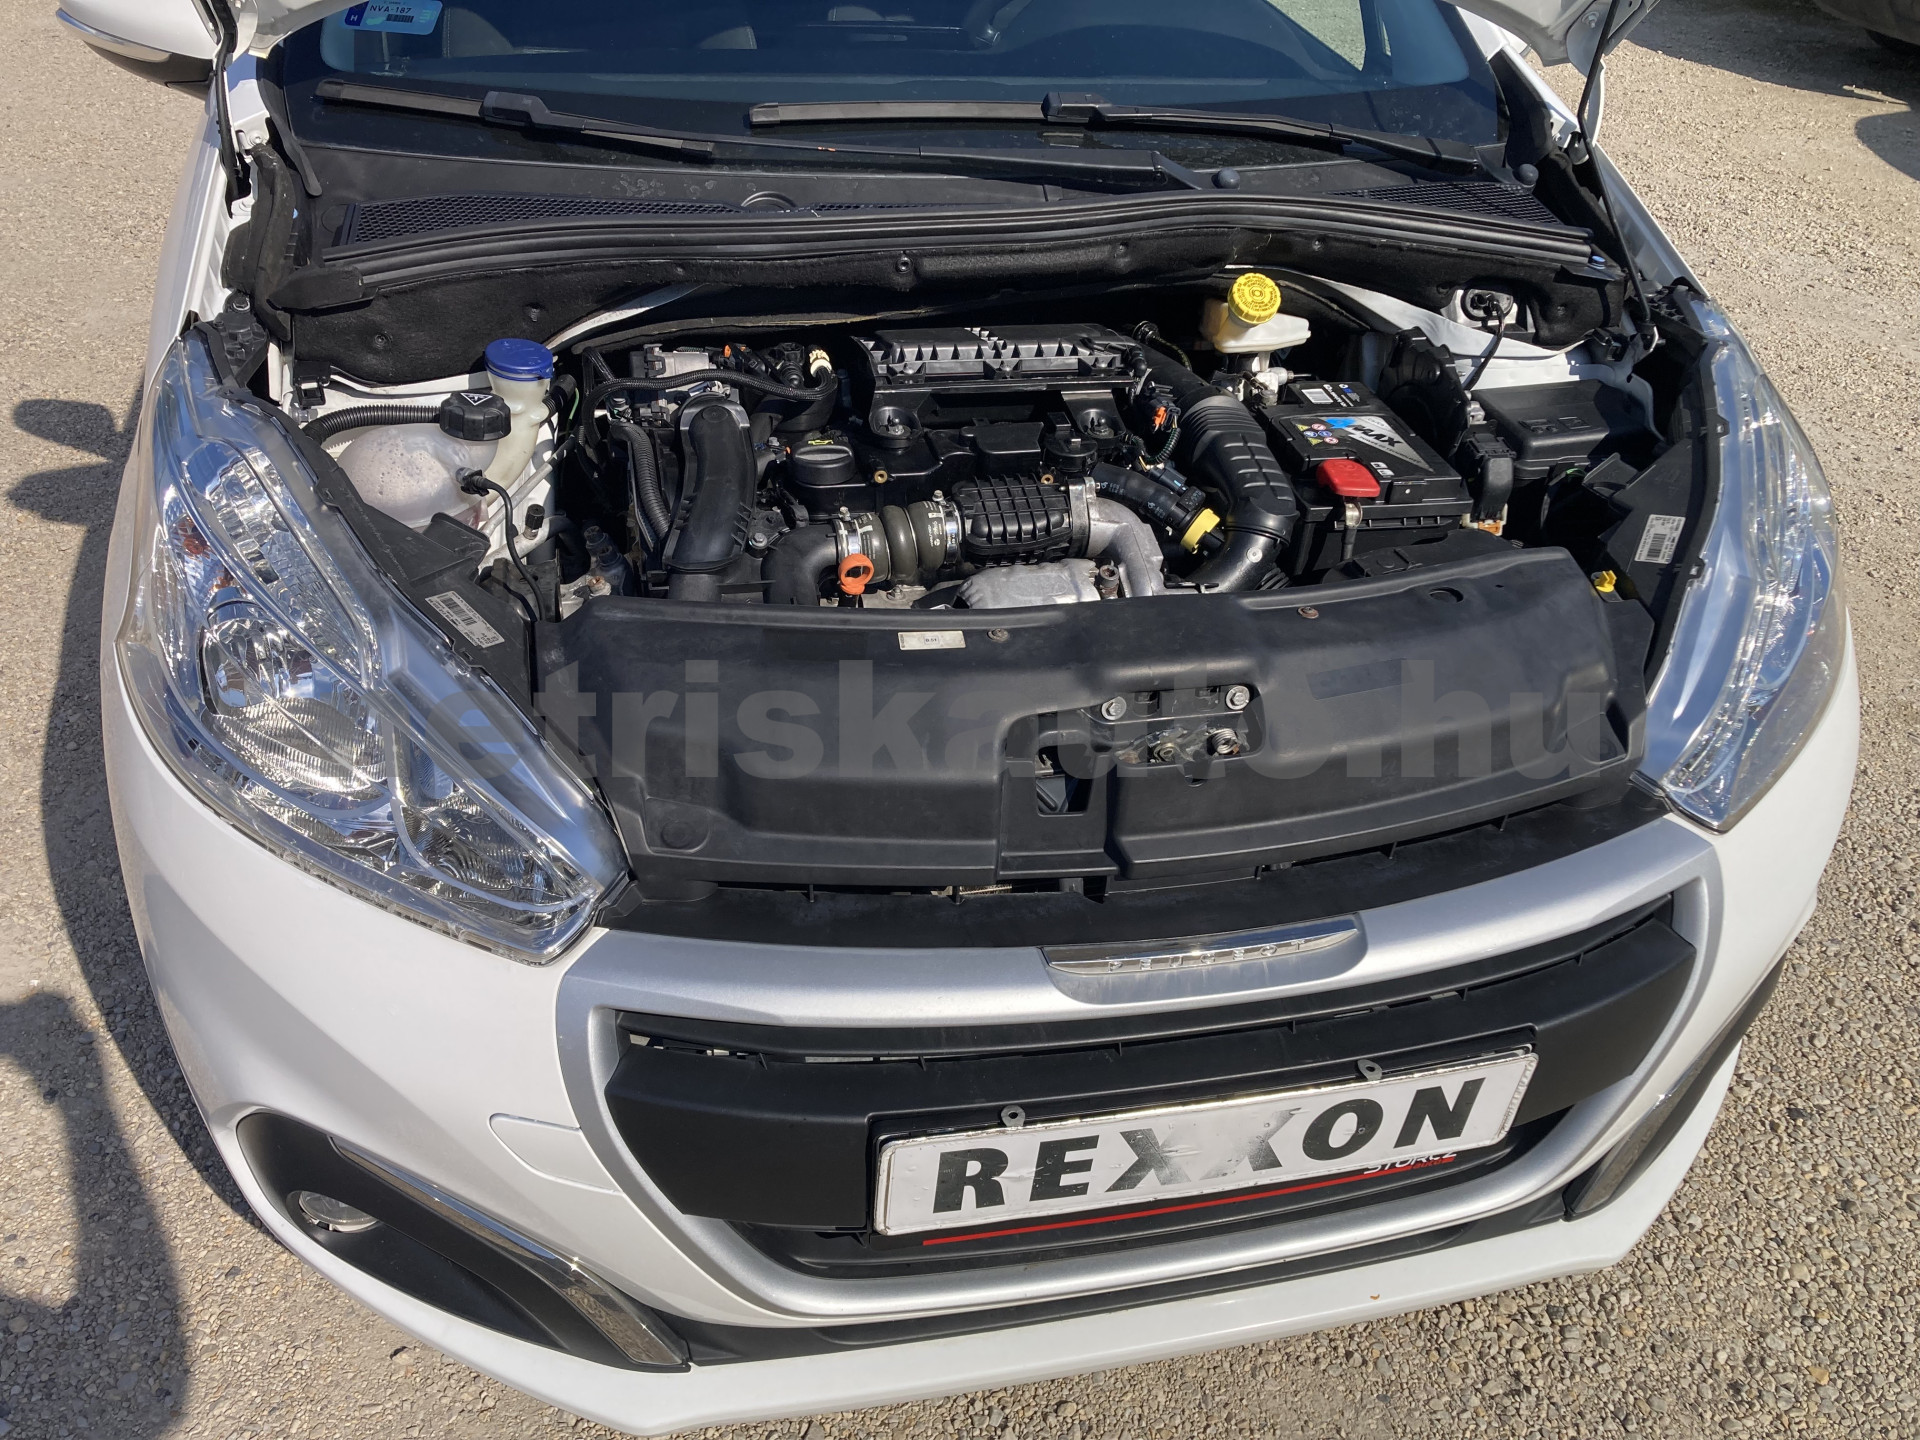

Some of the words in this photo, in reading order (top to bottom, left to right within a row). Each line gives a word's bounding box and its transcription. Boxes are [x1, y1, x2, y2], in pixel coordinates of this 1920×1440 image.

[369, 5, 412, 14] NVA-187
[1107, 939, 1305, 973] PEUGEOT
[932, 1077, 1486, 1214] REXXON
